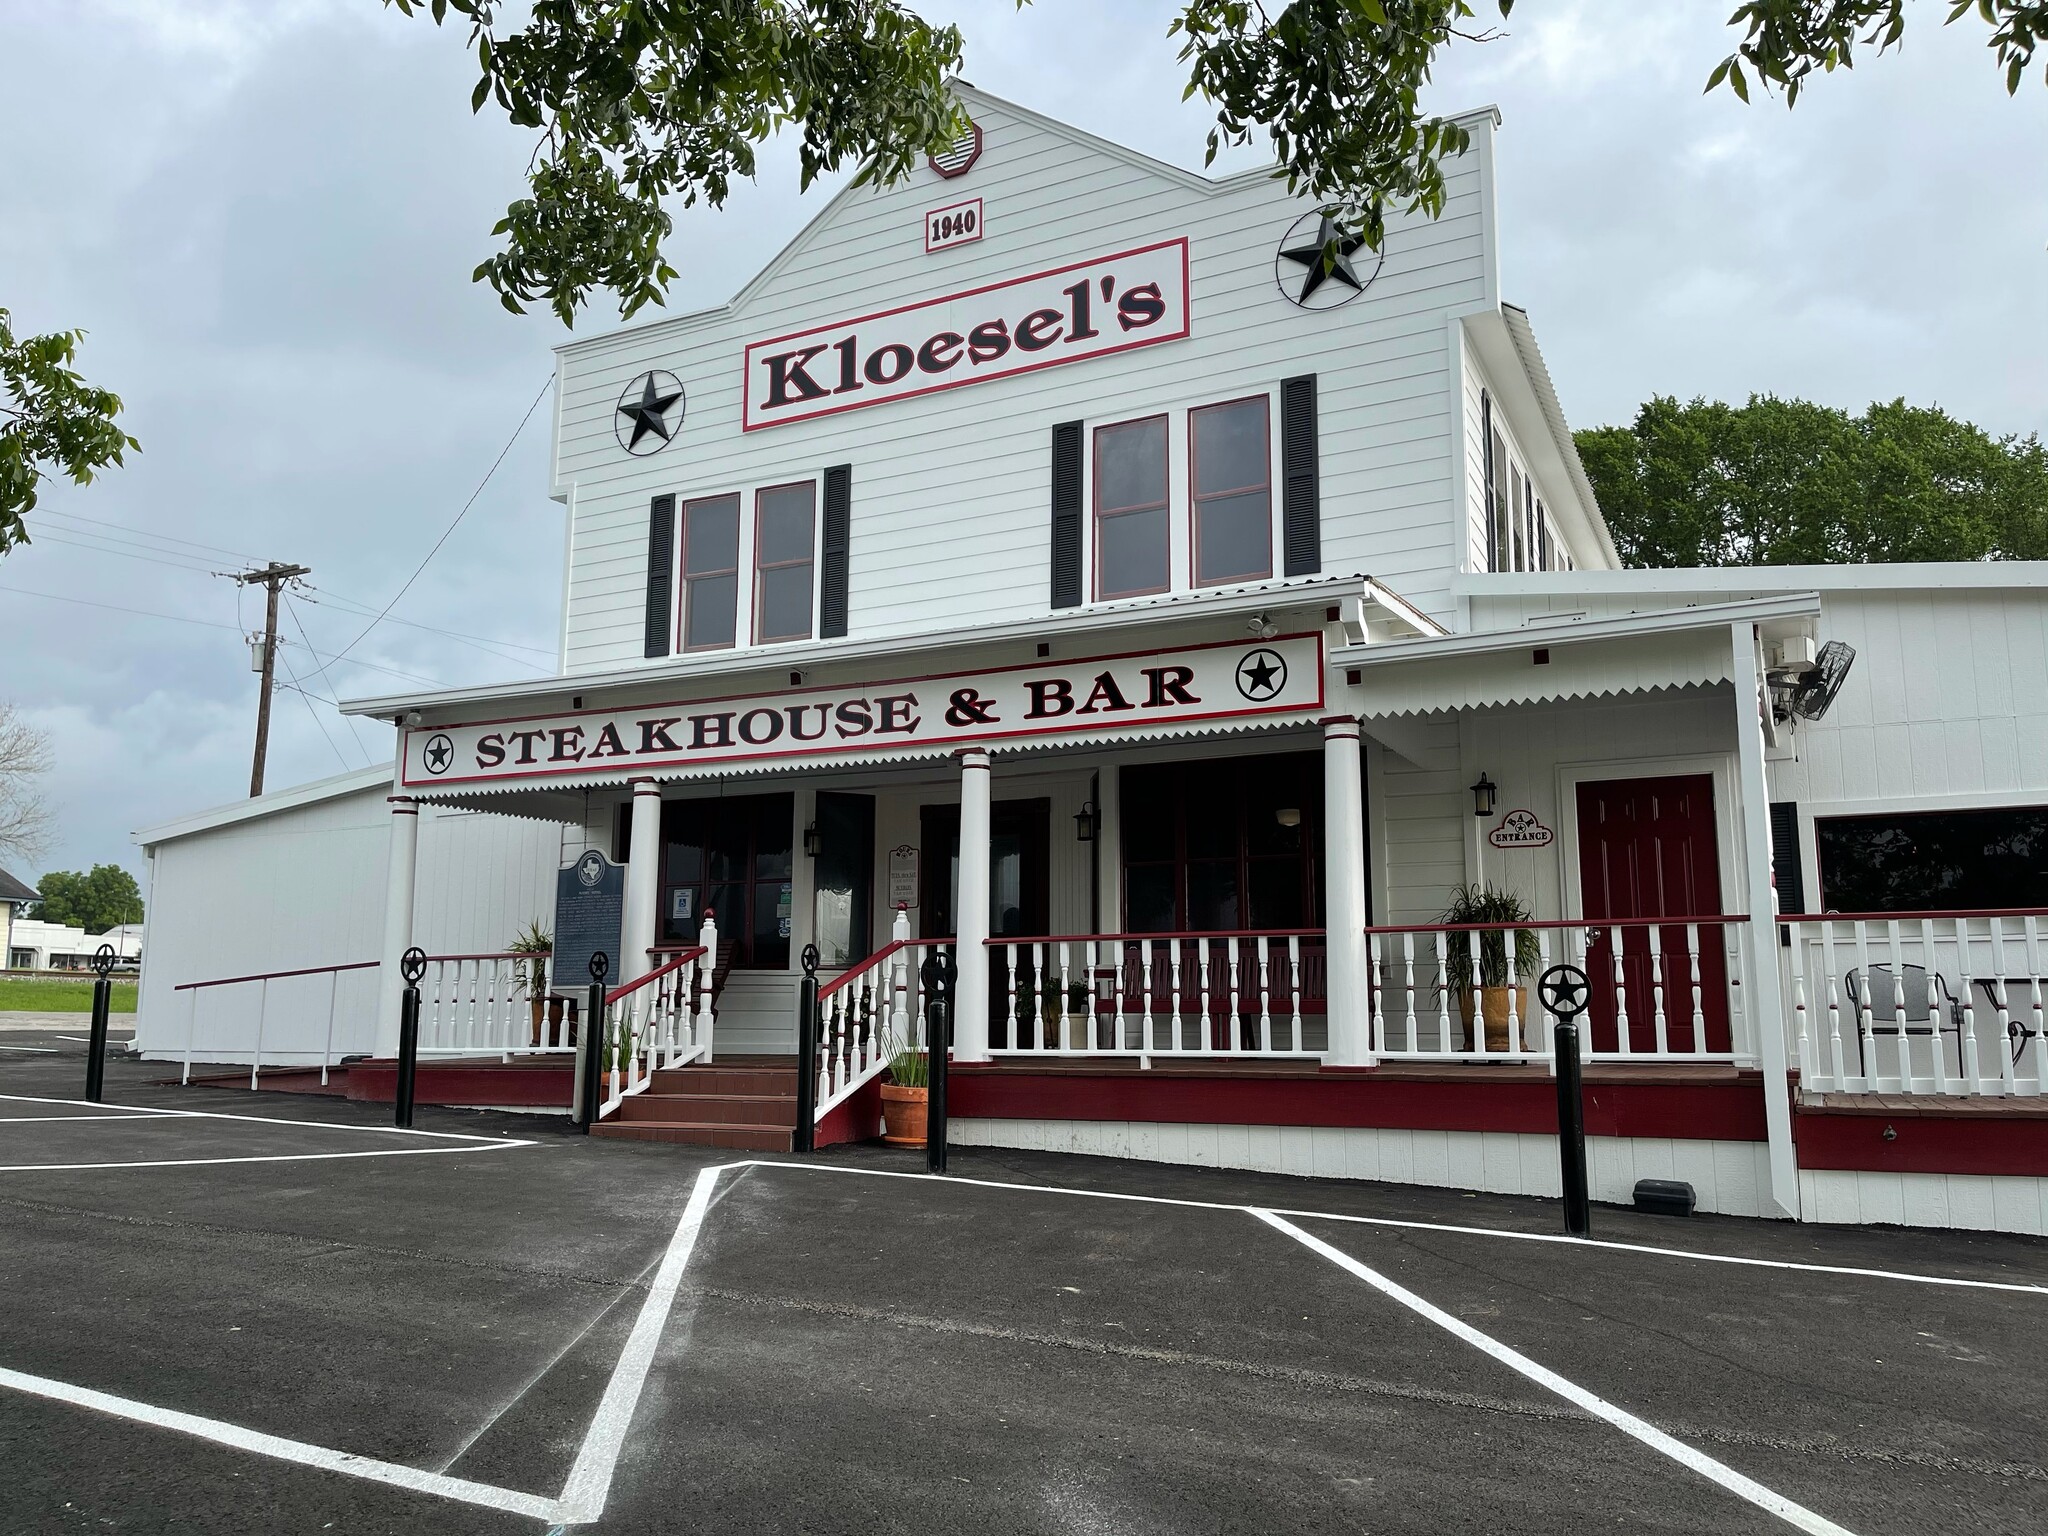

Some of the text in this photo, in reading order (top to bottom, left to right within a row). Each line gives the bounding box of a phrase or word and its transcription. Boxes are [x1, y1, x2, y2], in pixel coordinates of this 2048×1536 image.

[932, 209, 976, 242] 1940
[759, 274, 1167, 411] Kloesel's
[475, 665, 1202, 770] STEAKHOUSE & BAR
[1495, 831, 1548, 842] ENTRANCE
[1506, 813, 1535, 828] BAR
